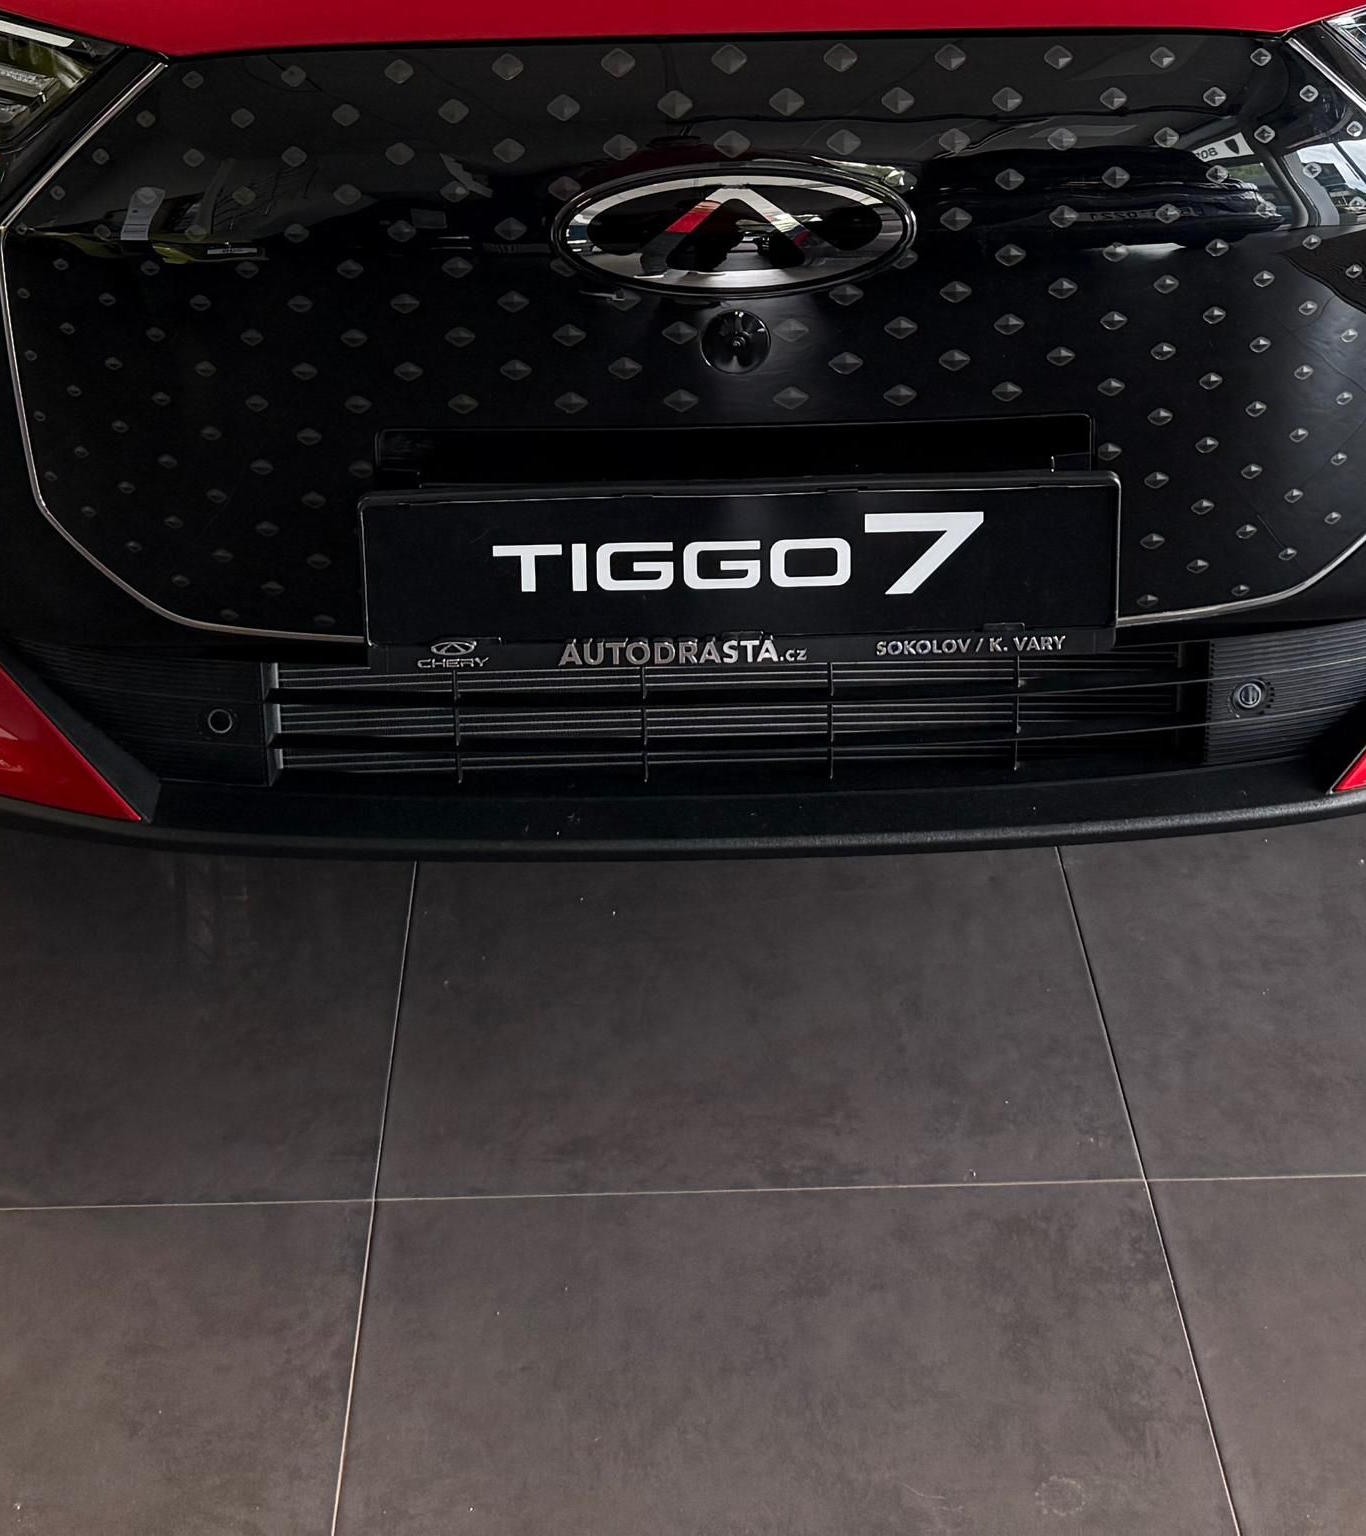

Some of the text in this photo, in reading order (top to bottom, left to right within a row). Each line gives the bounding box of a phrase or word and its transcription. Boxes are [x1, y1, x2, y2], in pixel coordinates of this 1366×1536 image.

[492, 511, 984, 595] TIGGO 7
[558, 638, 808, 666] AUTODRASTA.cz
[876, 635, 1066, 656] SOKOLOV / K. VARY
[417, 657, 489, 668] CHERY
